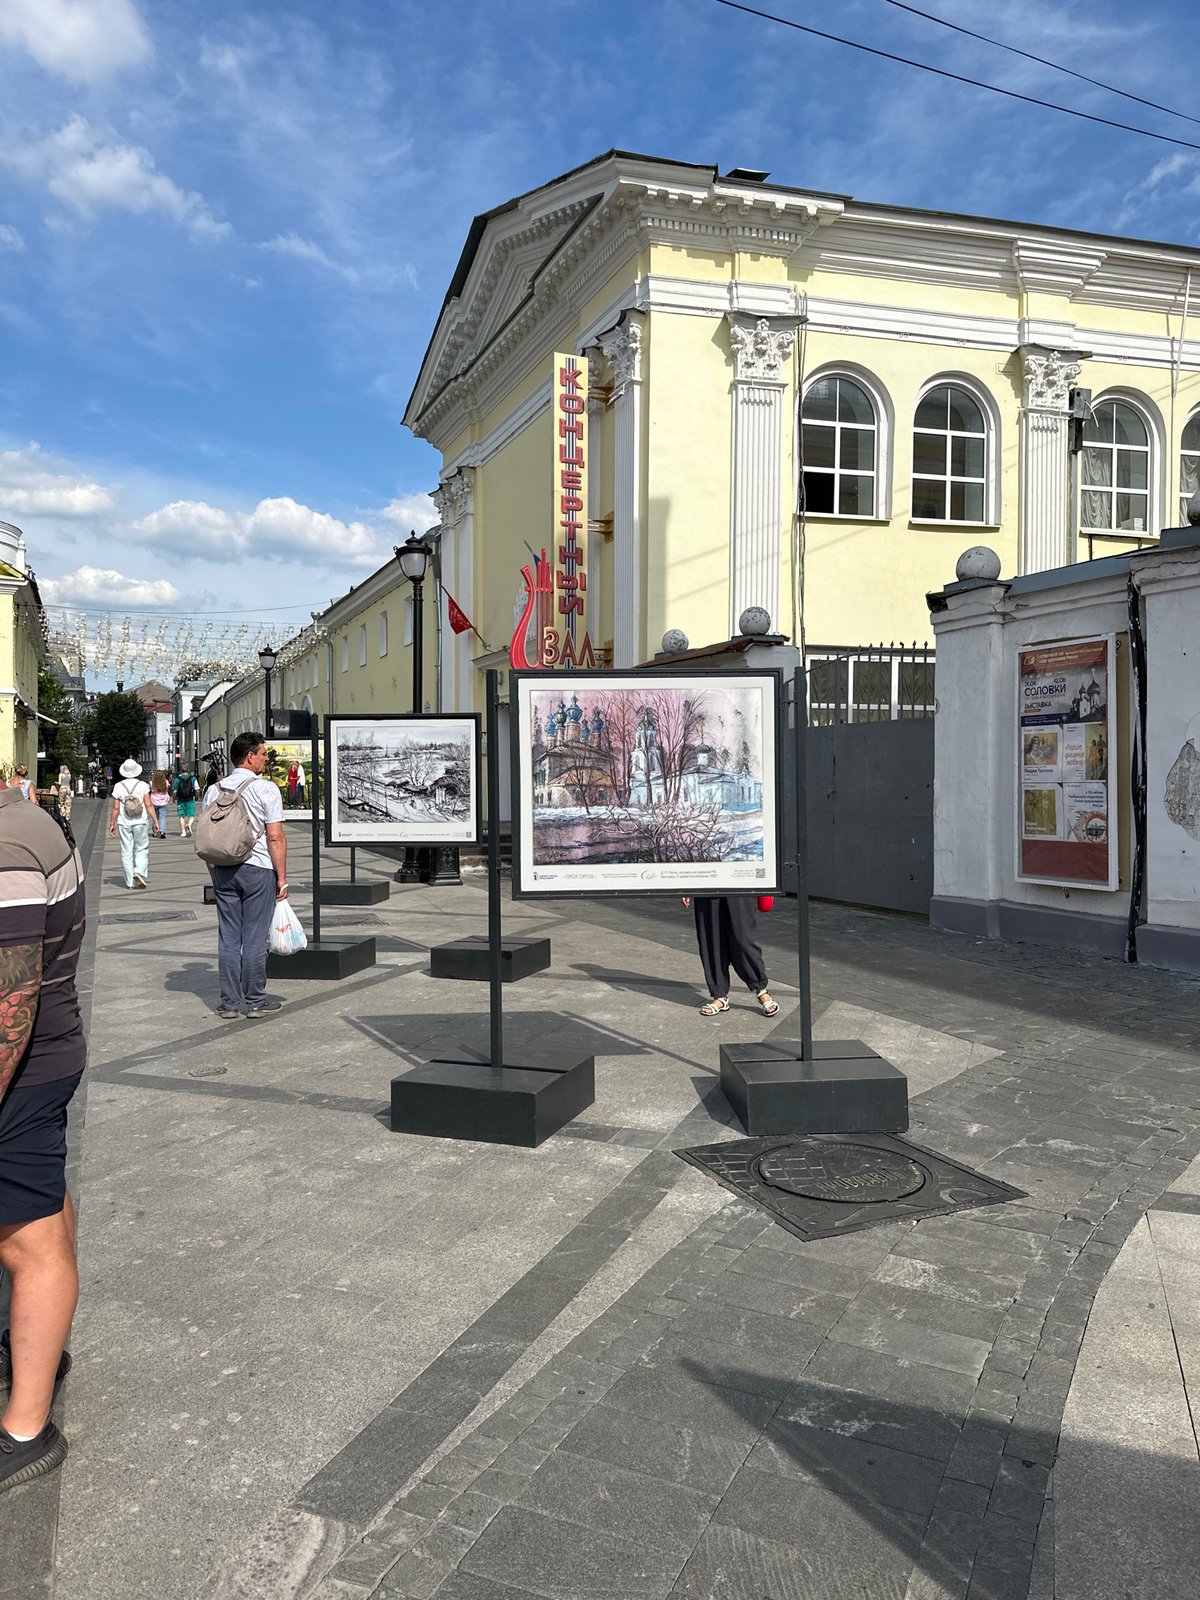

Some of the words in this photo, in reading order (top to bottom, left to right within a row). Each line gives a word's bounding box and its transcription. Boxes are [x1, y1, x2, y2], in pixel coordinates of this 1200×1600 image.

[557, 366, 586, 616] КОНЦЕРТНЫЙ
[543, 626, 596, 666] ЗАЛ
[1024, 684, 1067, 697] СОЛОВКИ
